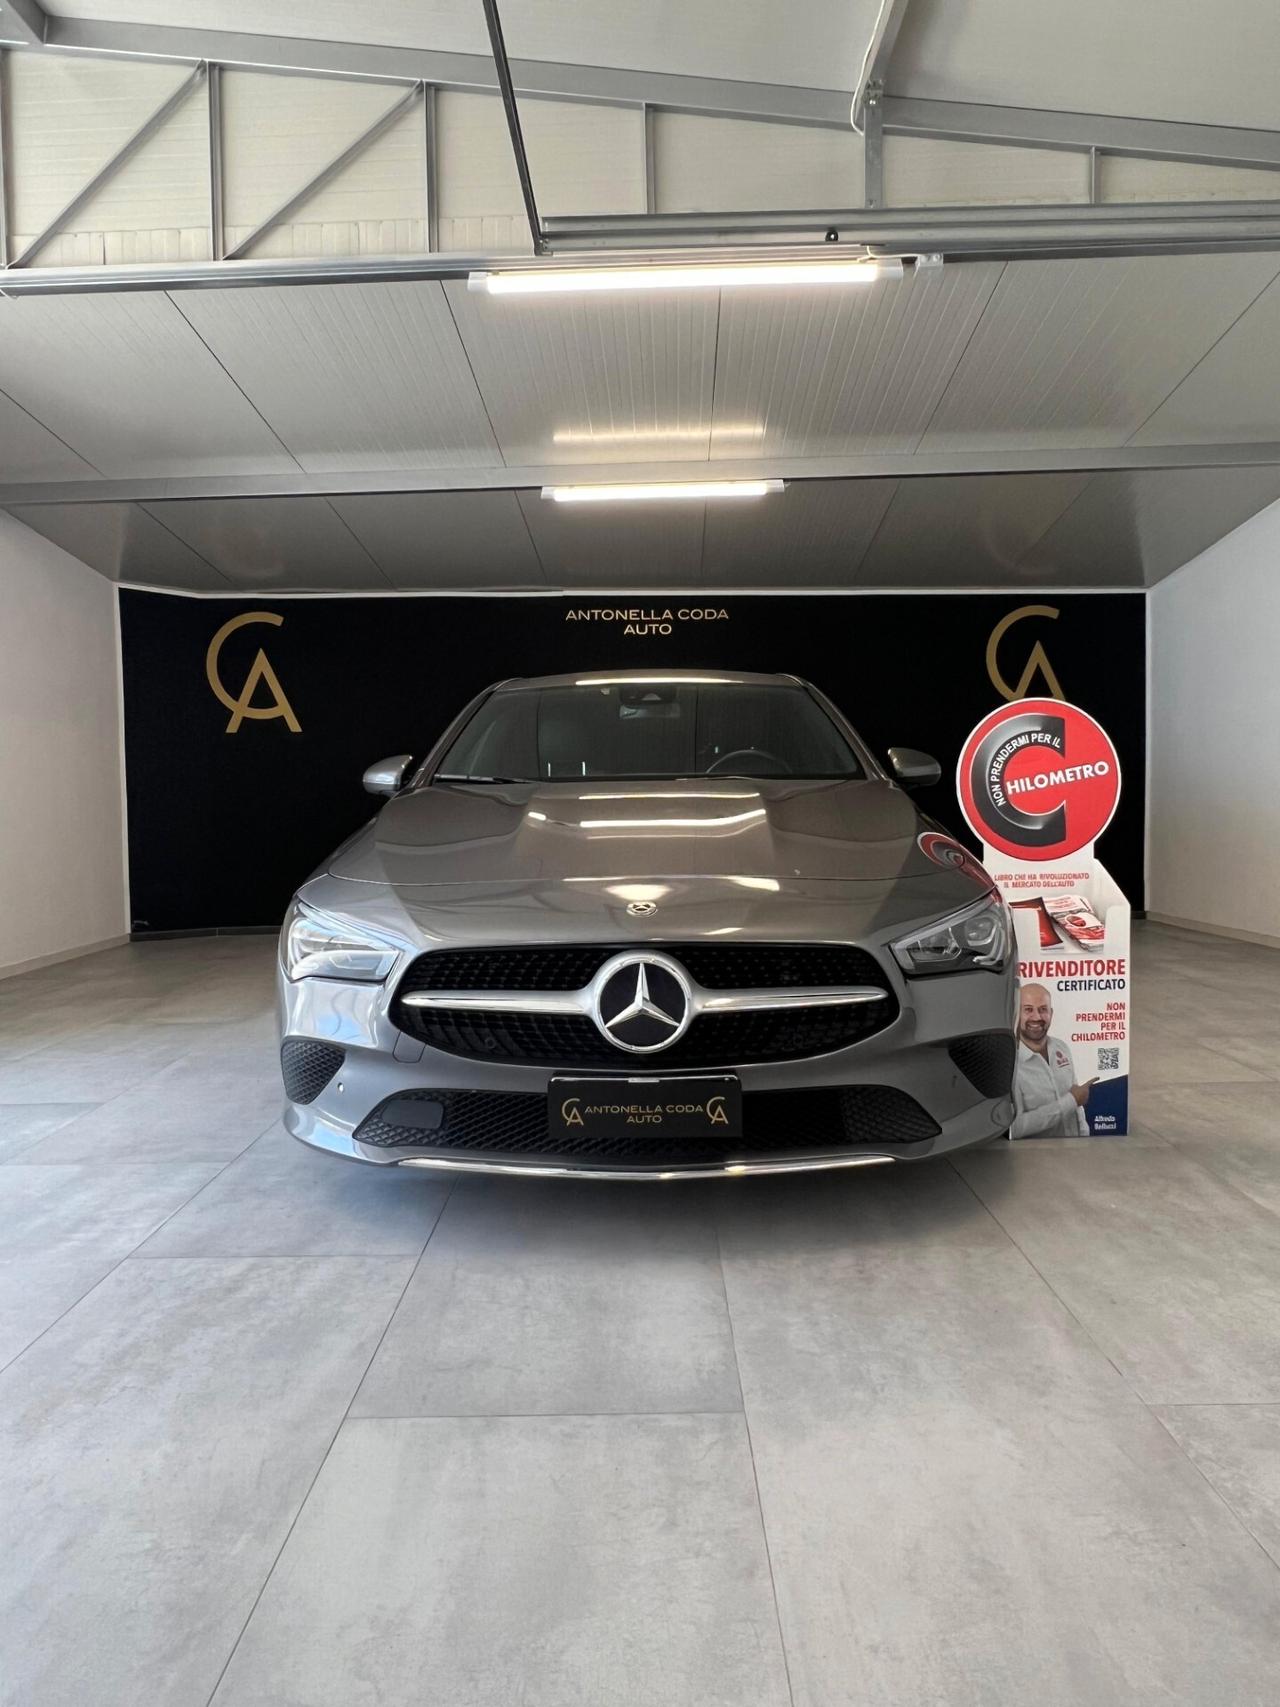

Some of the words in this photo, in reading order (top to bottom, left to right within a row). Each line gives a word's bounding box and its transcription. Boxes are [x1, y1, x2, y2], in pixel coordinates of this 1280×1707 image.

[565, 609, 674, 621] ANTONELLA
[677, 609, 729, 620] CODA
[623, 623, 673, 635] AUTO
[1031, 732, 1052, 744] PER
[1052, 736, 1061, 749] IL
[990, 734, 1030, 782] PRENDERMI
[990, 784, 1007, 807] NON
[1014, 873, 1027, 881] CHE
[1018, 959, 1126, 978] RIVENDITORE
[1057, 978, 1126, 992] CERTIFICATO
[1106, 1002, 1126, 1011] NON
[1076, 1012, 1126, 1022] PRENDERMI
[1101, 1022, 1117, 1031] PER
[1118, 1022, 1126, 1030] IL
[1071, 1031, 1126, 1042] CHILOMETRO
[585, 1105, 664, 1114] ANTONELLA
[665, 1104, 704, 1113] CODA
[626, 1115, 663, 1124] AUTO
